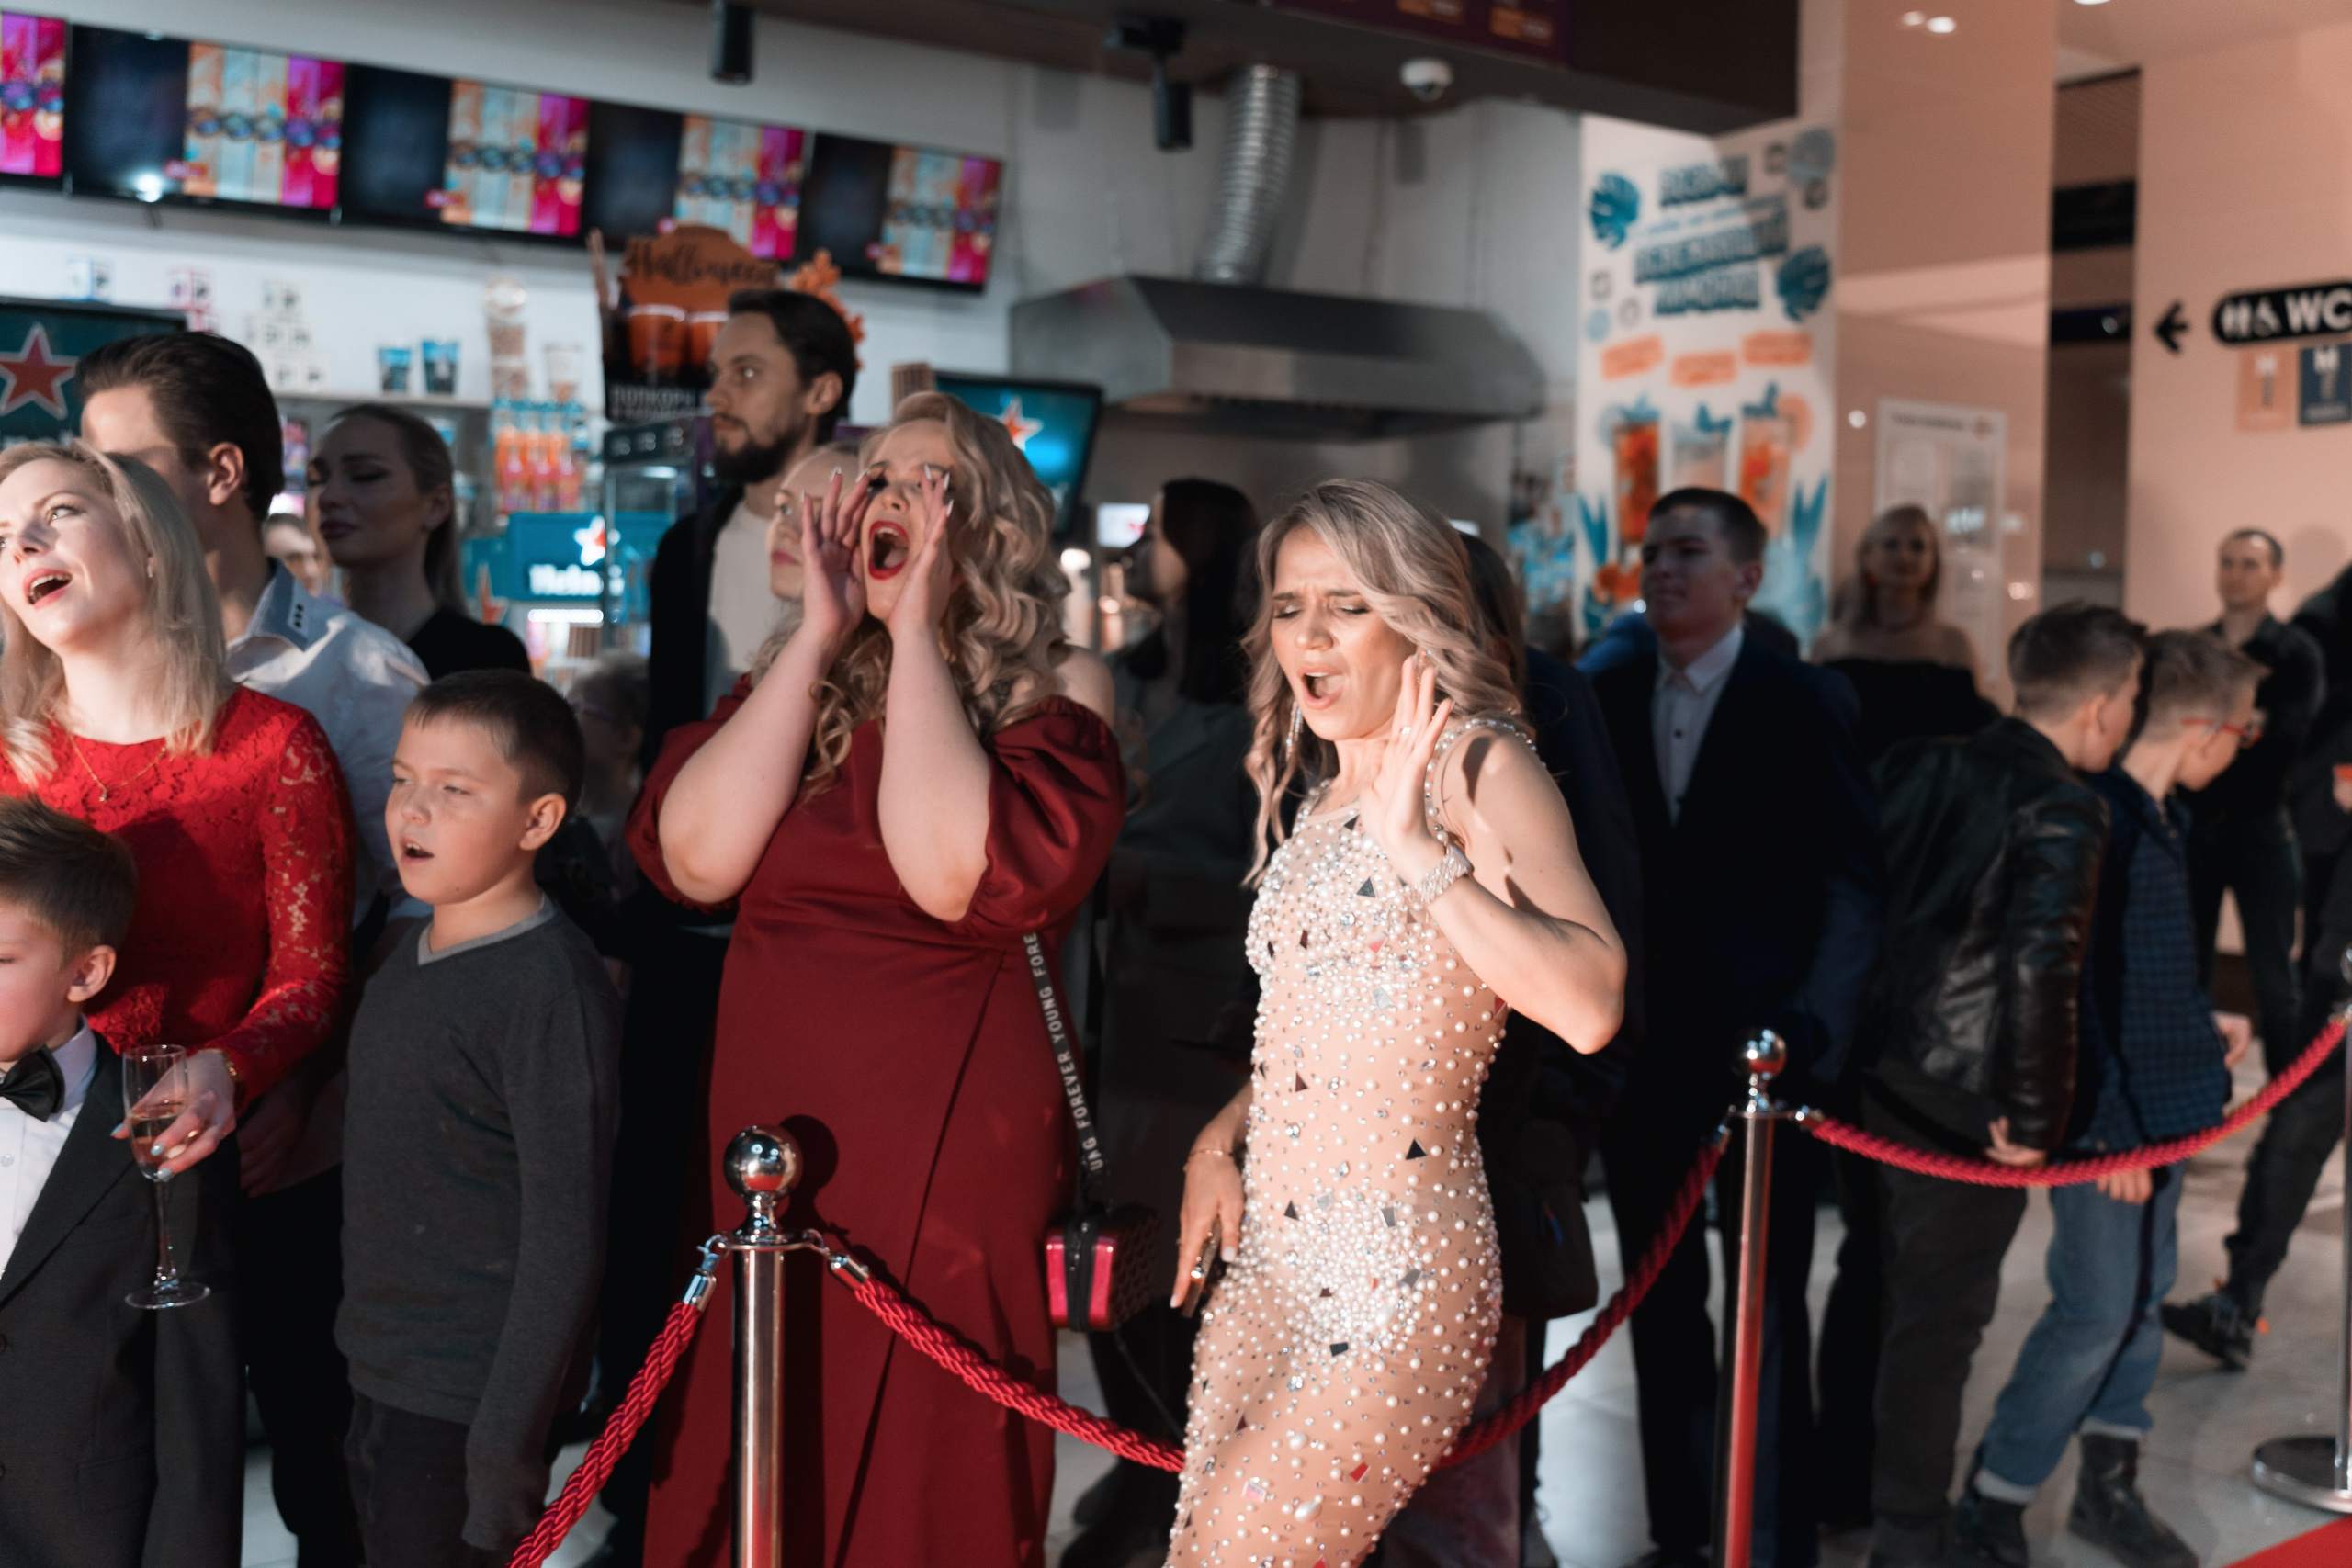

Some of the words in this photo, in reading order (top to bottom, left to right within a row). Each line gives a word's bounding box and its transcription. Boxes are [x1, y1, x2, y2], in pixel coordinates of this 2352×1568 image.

[2285, 288, 2352, 333] WC
[1023, 931, 1046, 976] FORE
[1038, 986, 1065, 1044] YOUNG
[1057, 1049, 1091, 1130] FOREVER
[1081, 1135, 1103, 1171] UNG
